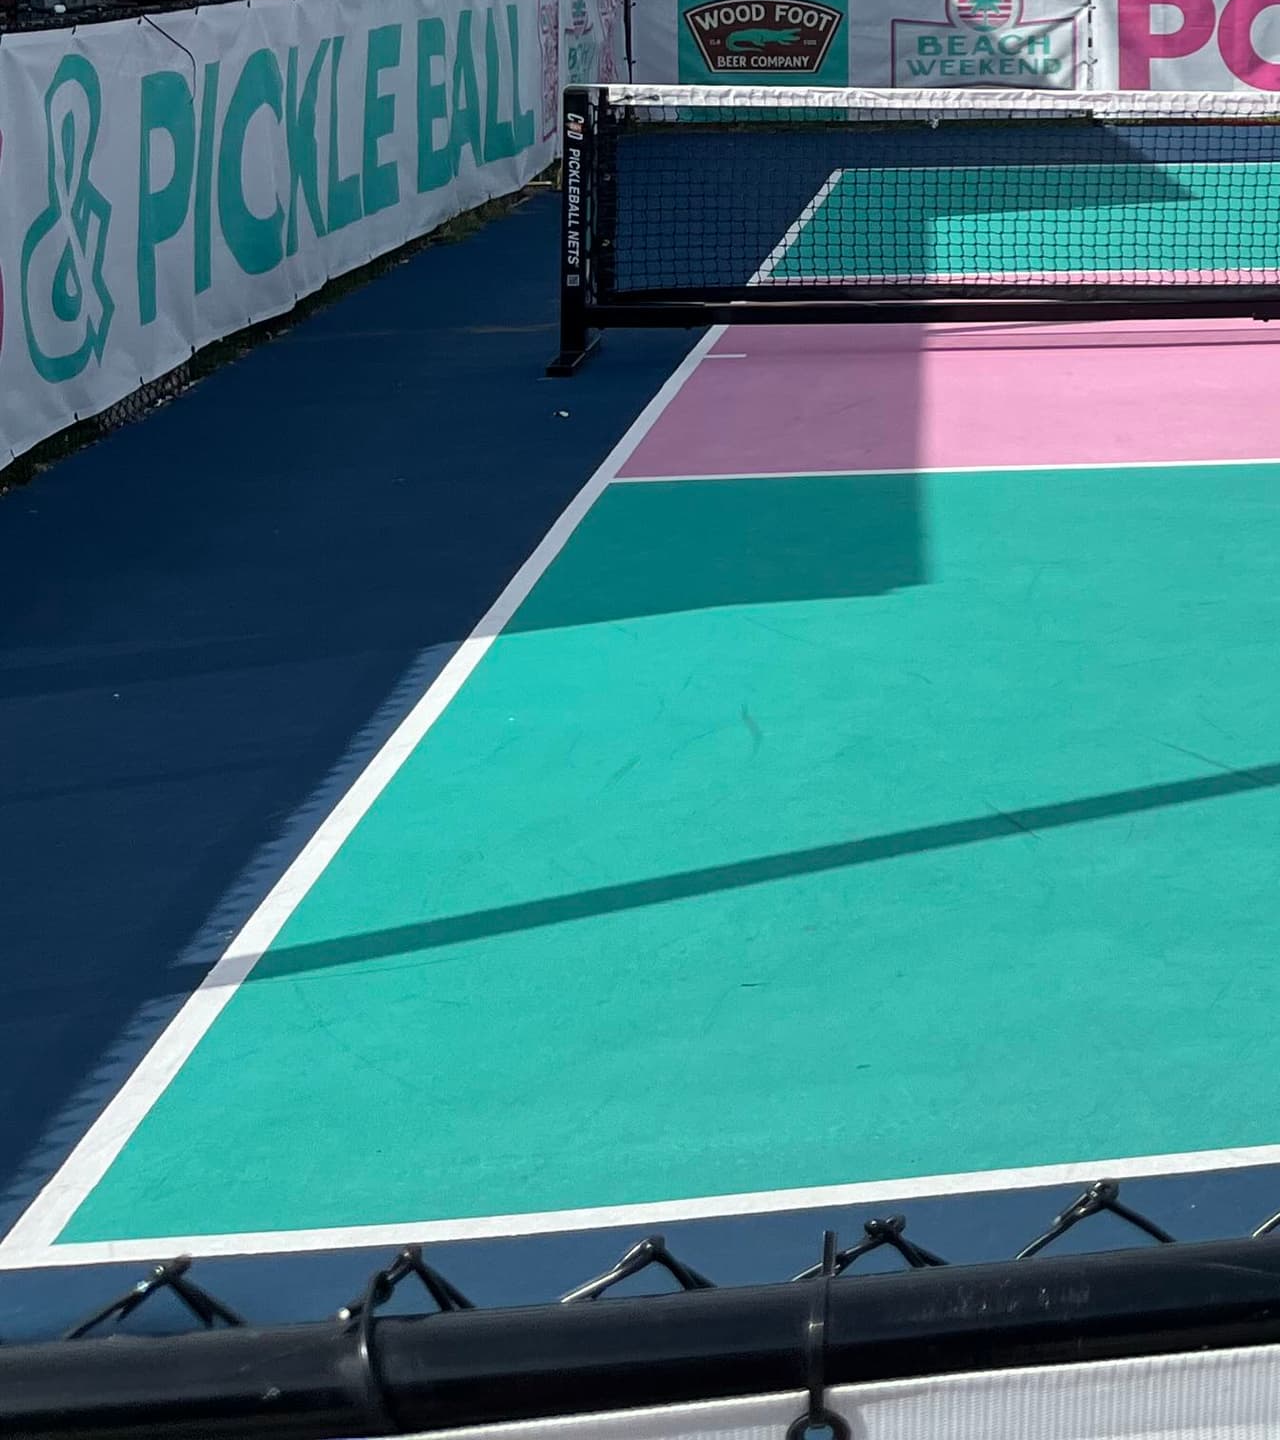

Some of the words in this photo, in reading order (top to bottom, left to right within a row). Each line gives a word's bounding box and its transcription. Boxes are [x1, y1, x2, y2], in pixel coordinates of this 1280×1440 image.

[695, 4, 765, 31] WOOD
[775, 5, 833, 32] FOOT
[918, 35, 1050, 56] BEACH
[717, 56, 746, 68] BEER
[751, 56, 809, 68] COMPANY
[907, 59, 1062, 76] WEEKEND
[21, 54, 115, 383] &
[138, 24, 402, 326] PICKLE
[417, 5, 533, 192] BALL
[568, 148, 580, 227] PICKLEBALL
[568, 230, 580, 265] NETS
